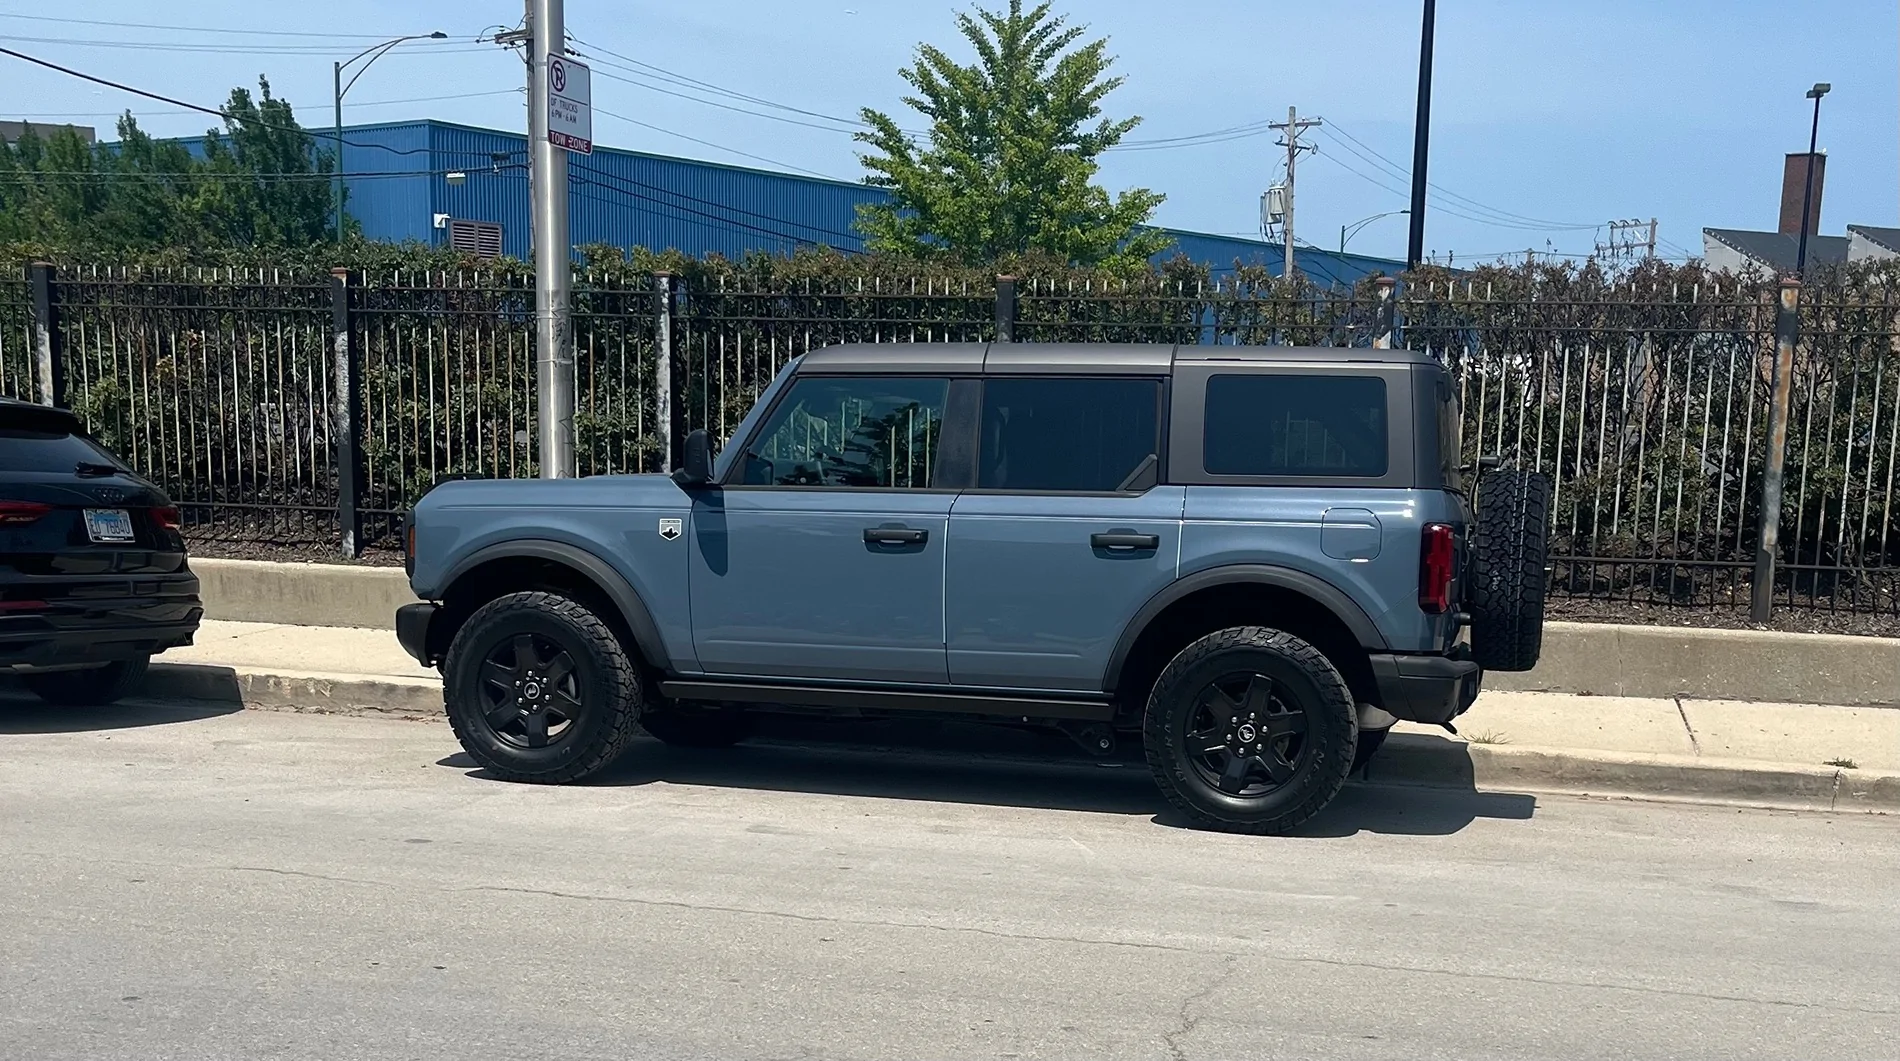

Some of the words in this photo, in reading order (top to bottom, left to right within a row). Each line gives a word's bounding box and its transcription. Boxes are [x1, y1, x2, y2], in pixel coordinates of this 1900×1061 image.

[560, 100, 578, 114] TRUCKS
[550, 131, 566, 146] TOW
[568, 136, 588, 152] ZONE
